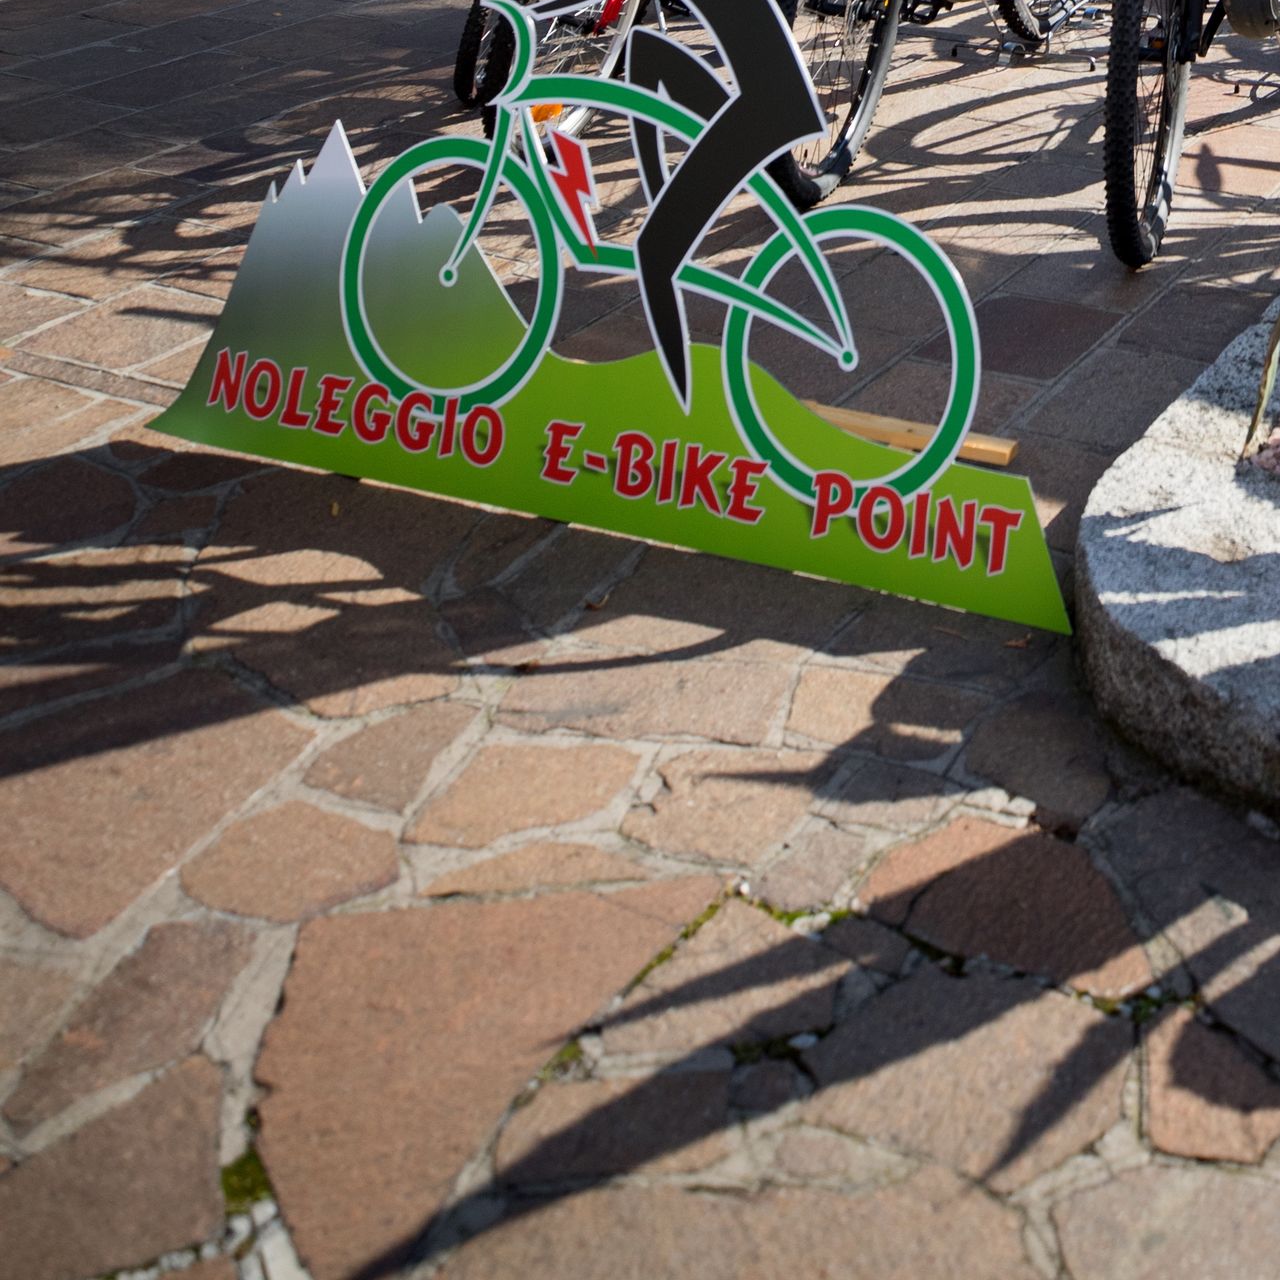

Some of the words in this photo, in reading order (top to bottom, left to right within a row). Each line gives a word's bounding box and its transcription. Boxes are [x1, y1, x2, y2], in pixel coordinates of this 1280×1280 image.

[207, 347, 506, 467] NOLEGGIO
[542, 419, 770, 524] E-BIKE
[811, 472, 1024, 576] POINT
